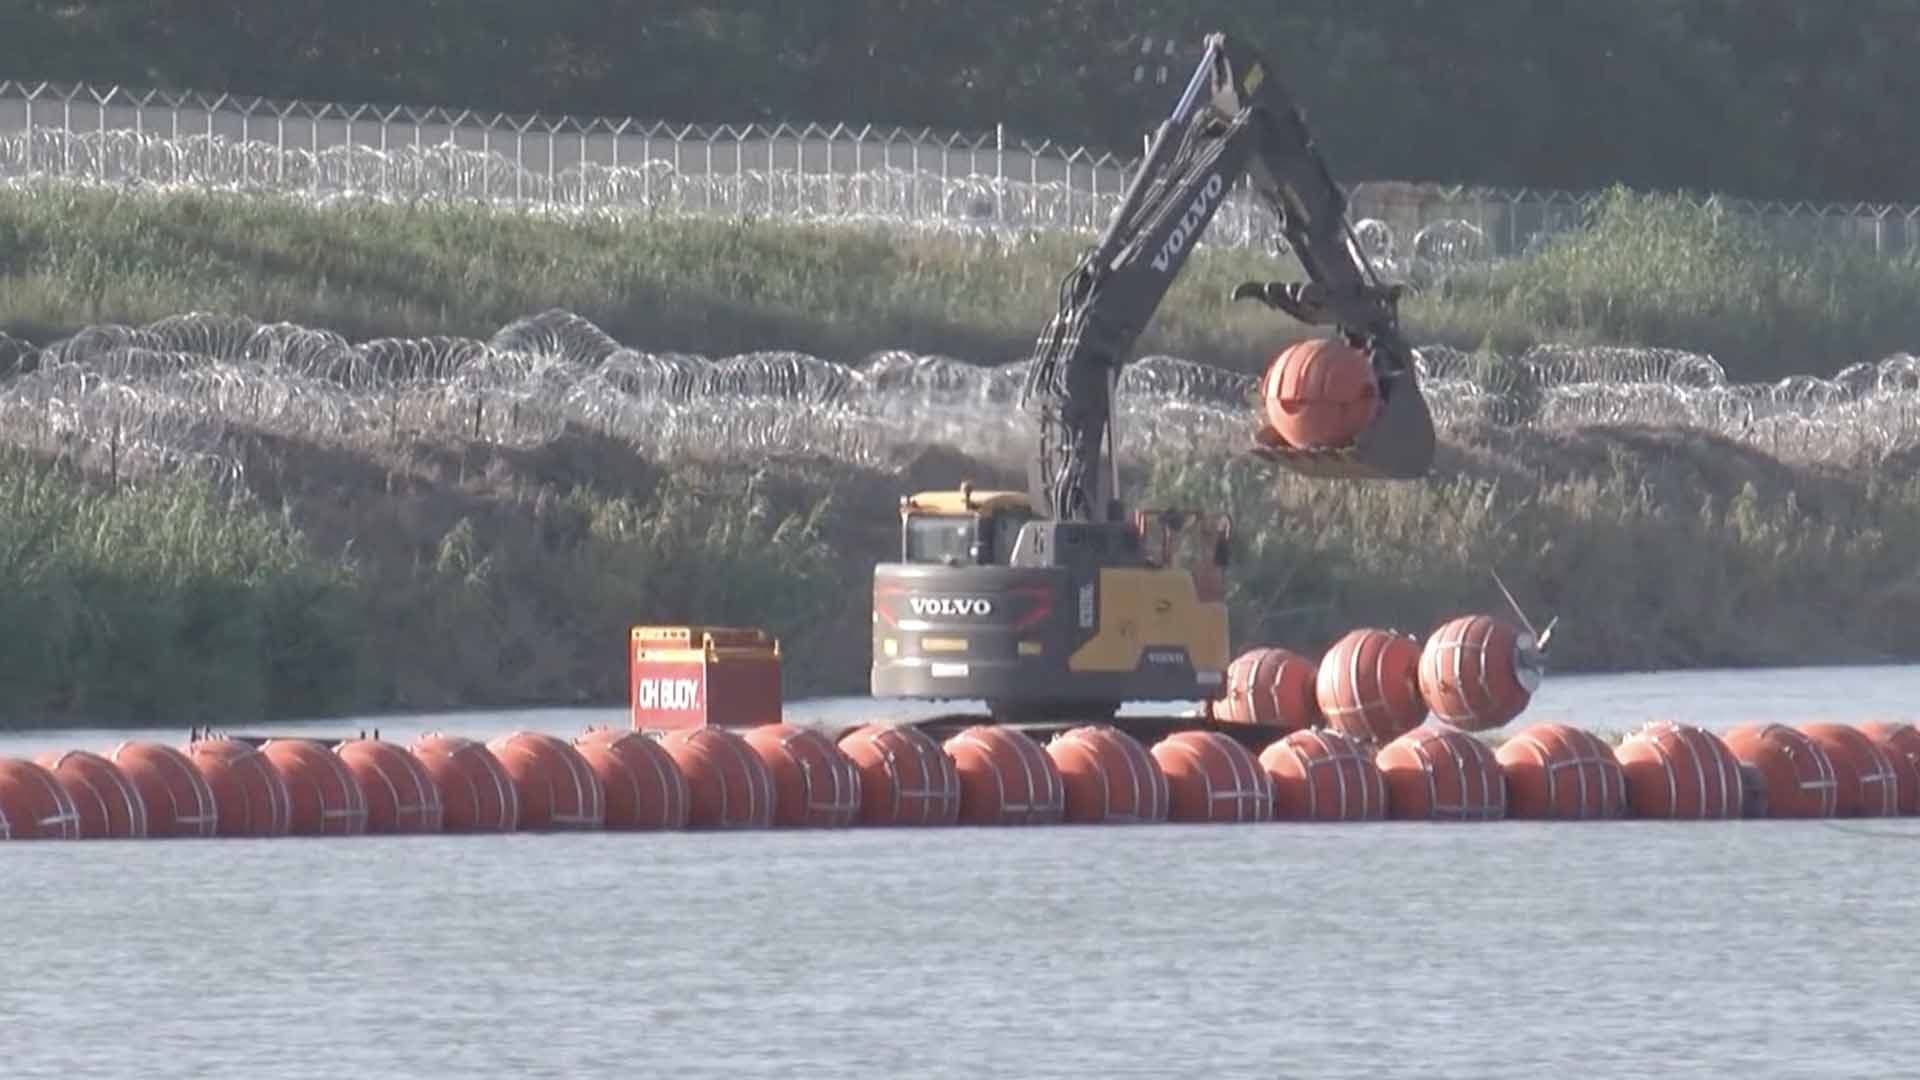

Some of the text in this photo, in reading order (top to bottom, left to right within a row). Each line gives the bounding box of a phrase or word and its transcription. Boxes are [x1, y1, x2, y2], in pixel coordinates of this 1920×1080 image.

[1150, 174, 1222, 272] VOLVO
[909, 597, 992, 616] VOLVO
[639, 678, 660, 709] OH
